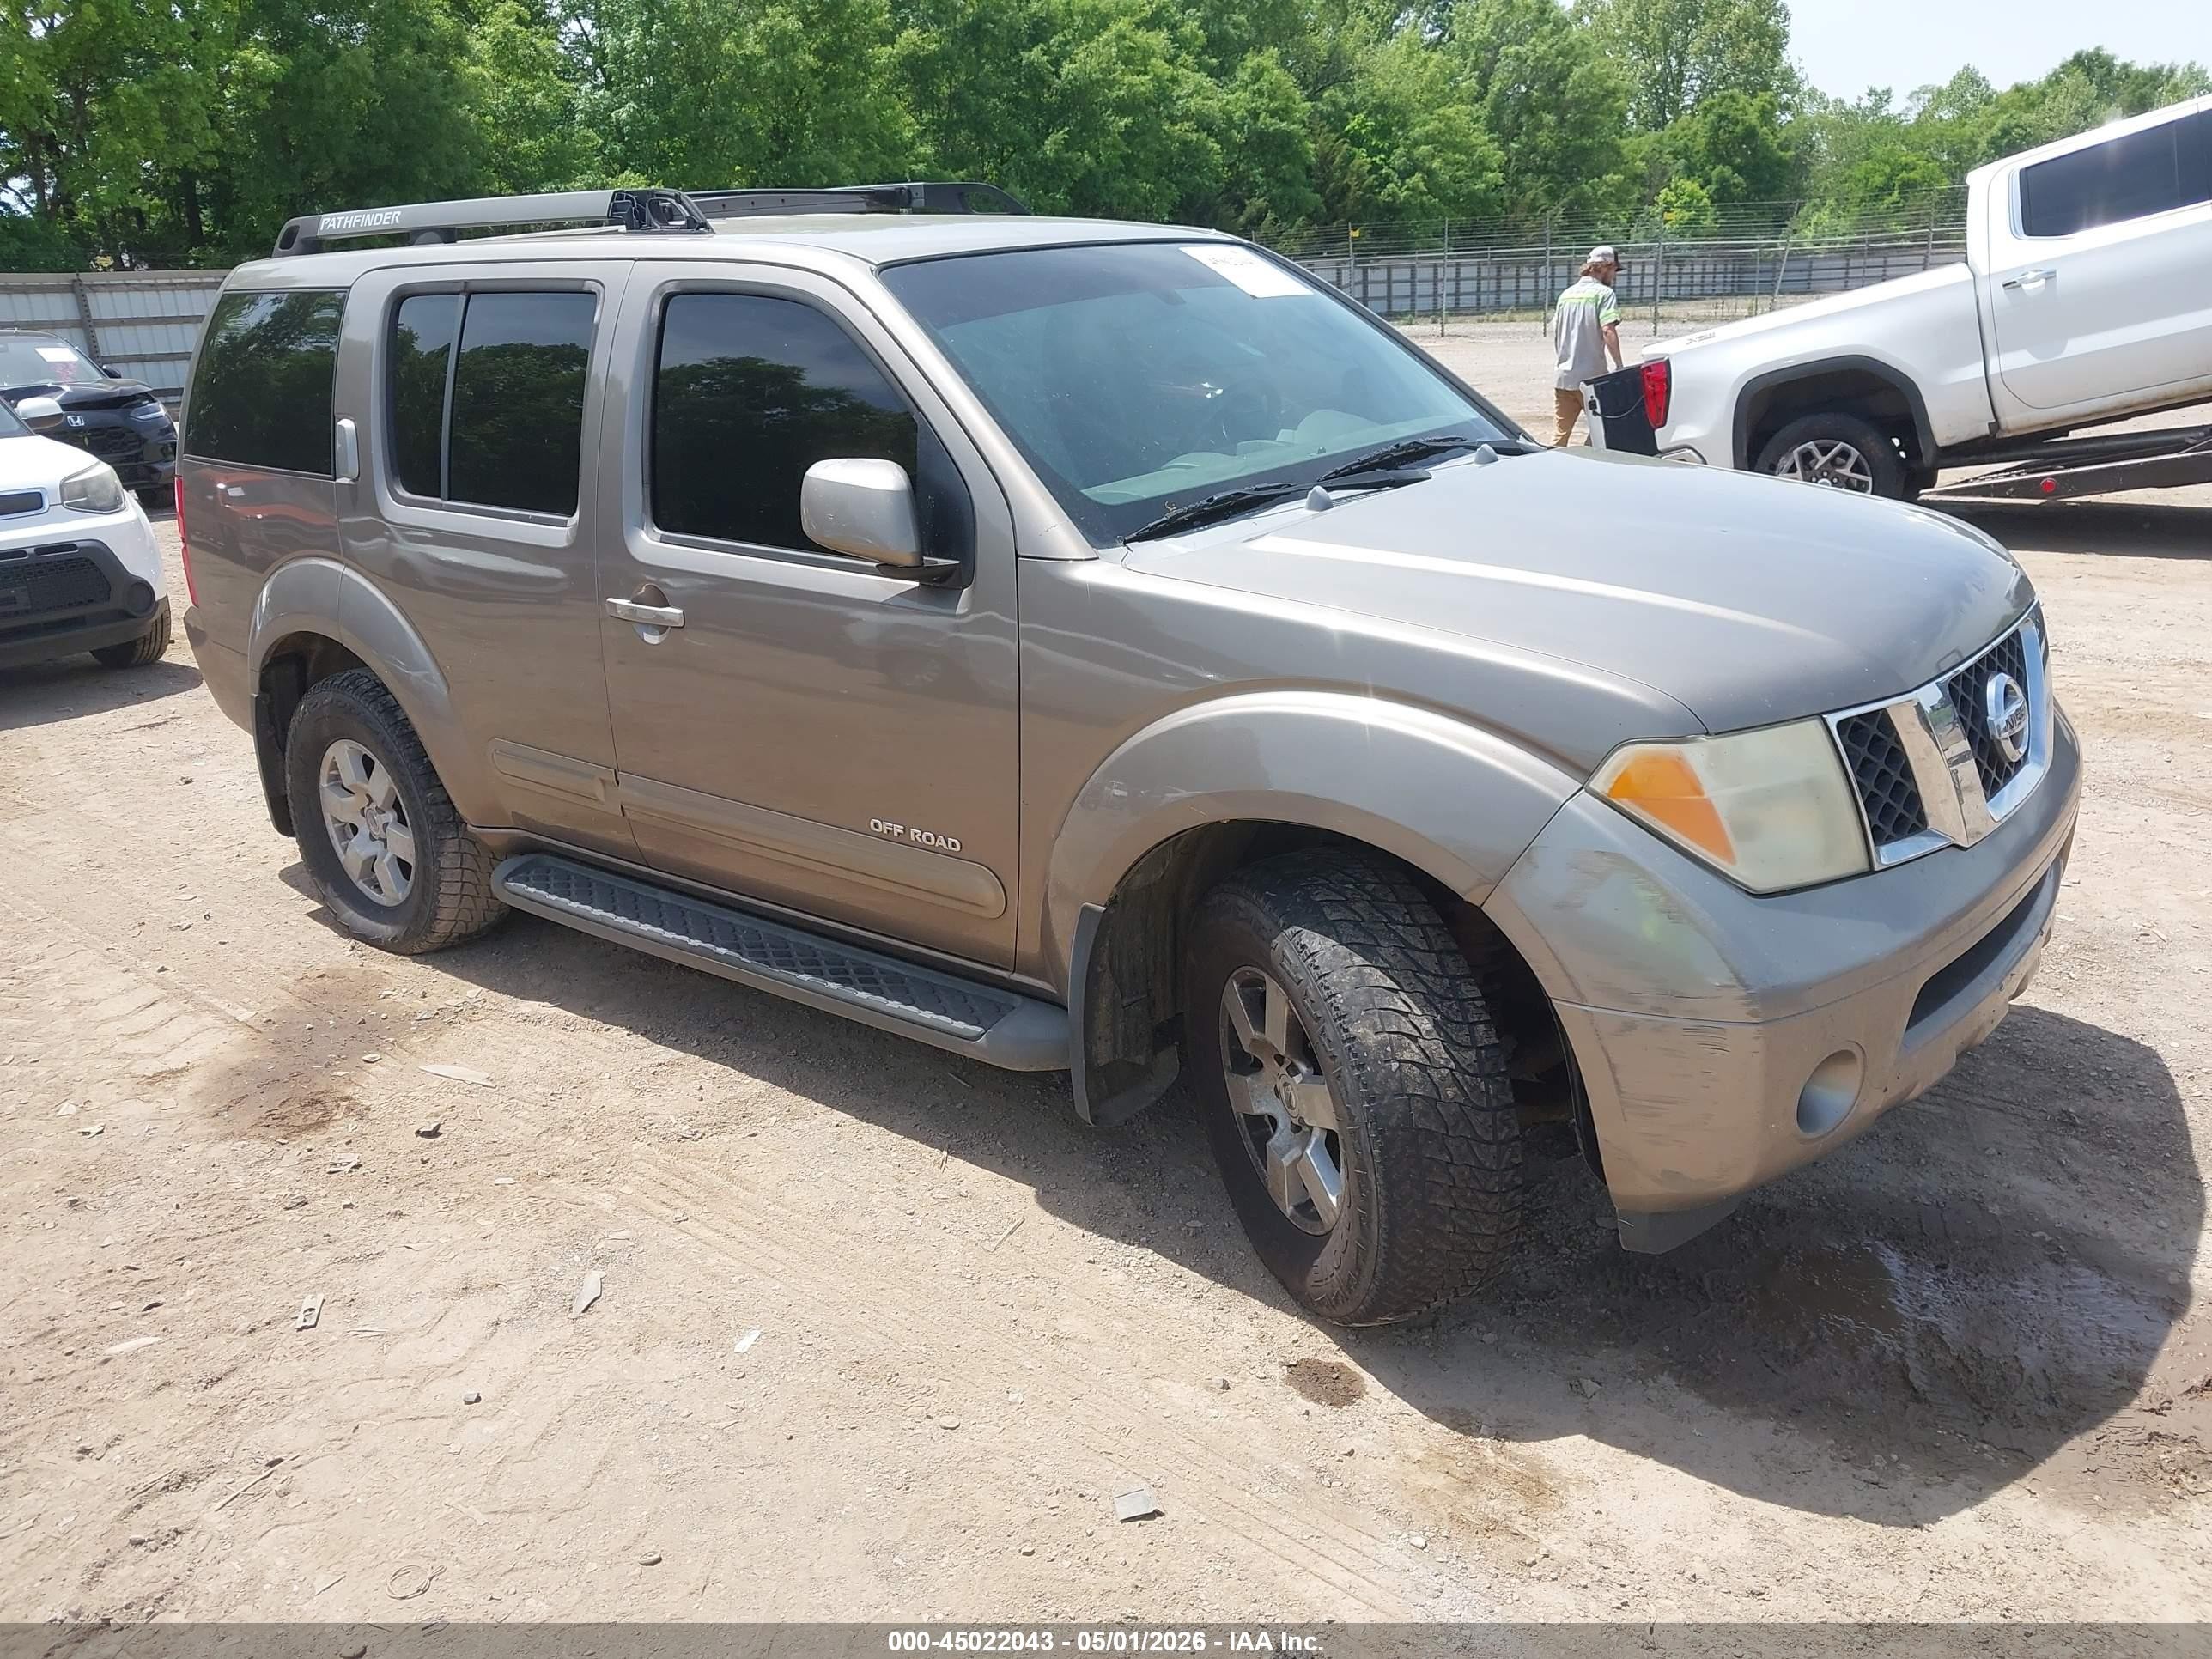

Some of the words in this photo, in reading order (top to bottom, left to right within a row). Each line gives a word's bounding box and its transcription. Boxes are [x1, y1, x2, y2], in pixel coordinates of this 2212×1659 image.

[319, 210, 402, 231] PATHFINDER
[870, 818, 904, 837] OFF
[909, 828, 961, 852] ROAD
